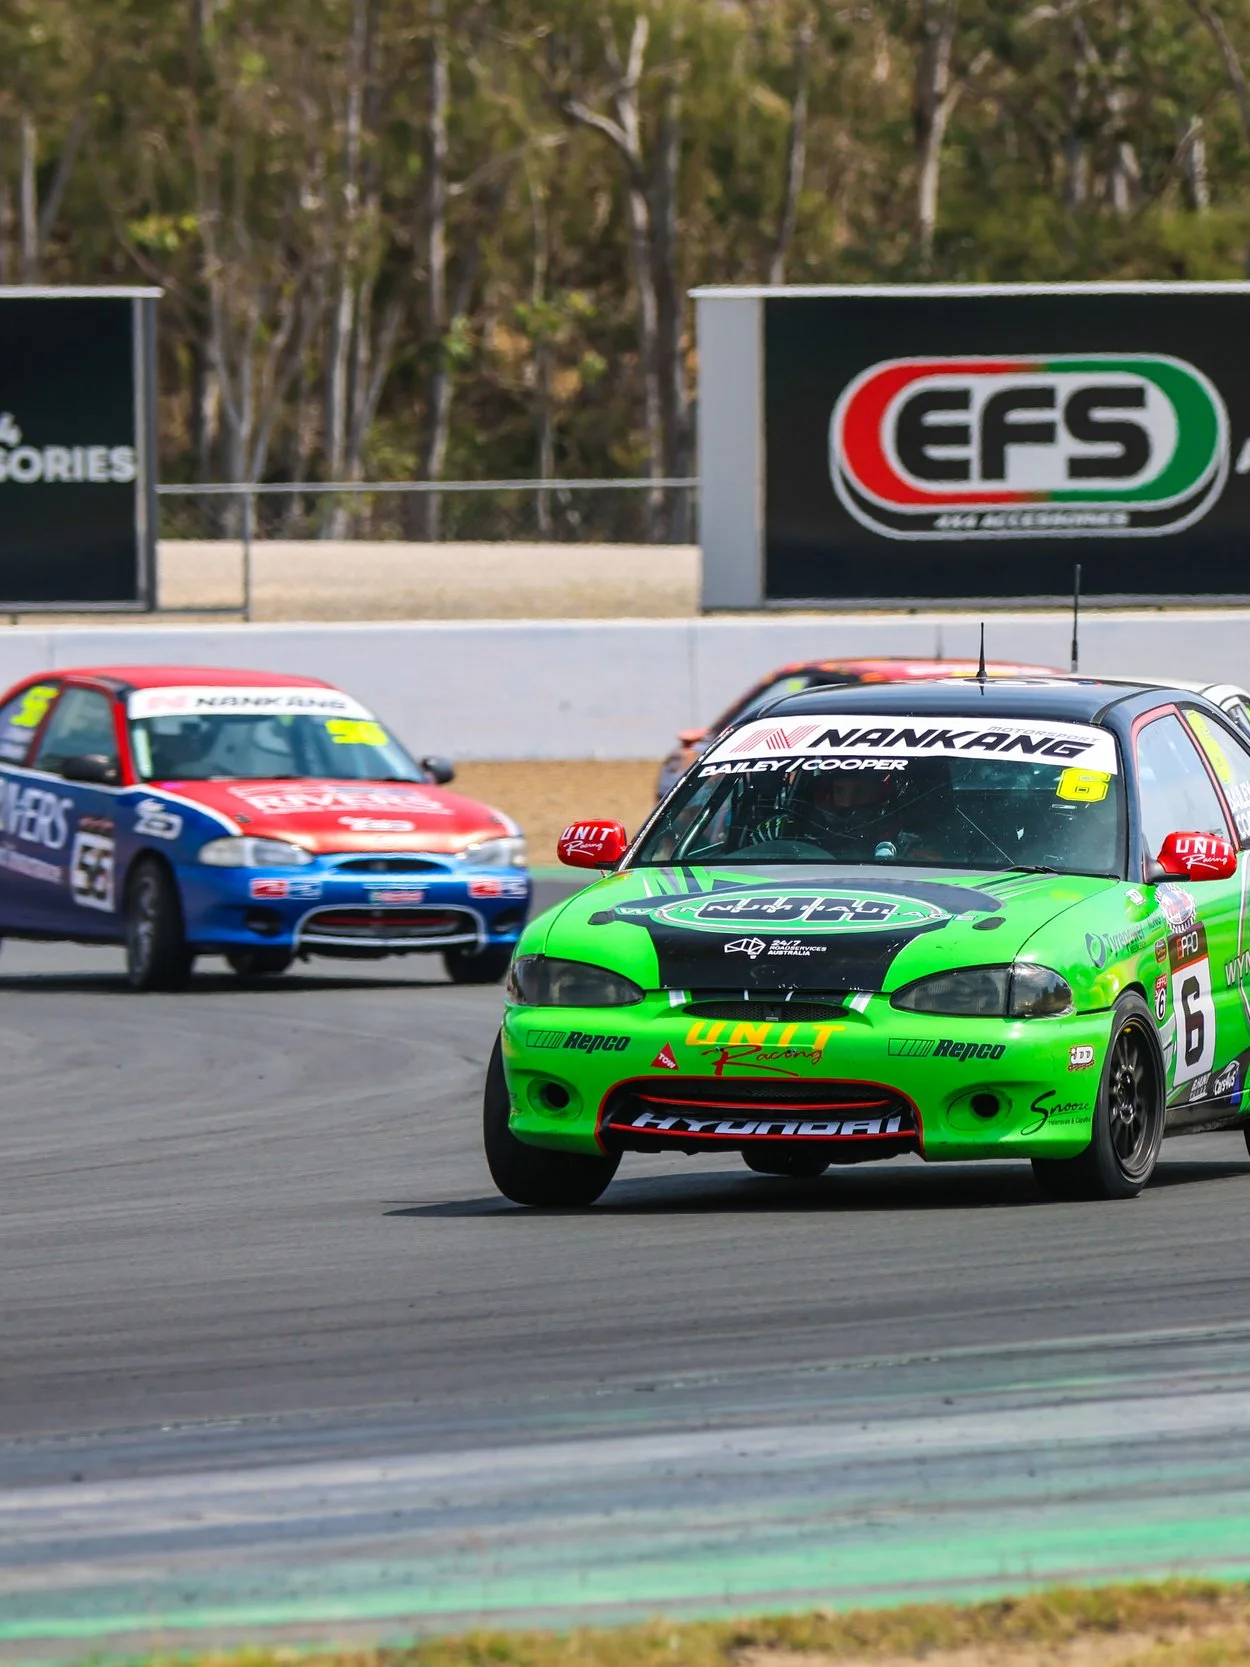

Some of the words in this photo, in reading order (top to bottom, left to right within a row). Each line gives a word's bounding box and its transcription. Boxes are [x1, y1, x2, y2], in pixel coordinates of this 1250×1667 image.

[896, 386, 1151, 481] EFS
[0, 446, 137, 484] ORIES
[196, 696, 347, 710] NANKANG
[806, 728, 1095, 759] NANKANG
[988, 726, 1101, 744] MOTORSPORT
[1056, 767, 1112, 803] 6
[560, 826, 615, 841] UNIT
[563, 840, 603, 857] Racing
[1175, 839, 1232, 854] UNIT
[1182, 854, 1228, 871] Racing
[771, 939, 801, 947] 24/7
[1158, 990, 1165, 1018] 6
[1181, 975, 1204, 1067] 6
[563, 1031, 631, 1054] Repco
[685, 1021, 846, 1050] UNIT
[657, 1052, 677, 1069] TOW
[701, 1043, 824, 1078] Racing
[932, 1039, 1006, 1063] Repco
[631, 1112, 902, 1135] HYUNDAI
[1020, 1090, 1090, 1136] Snooze
